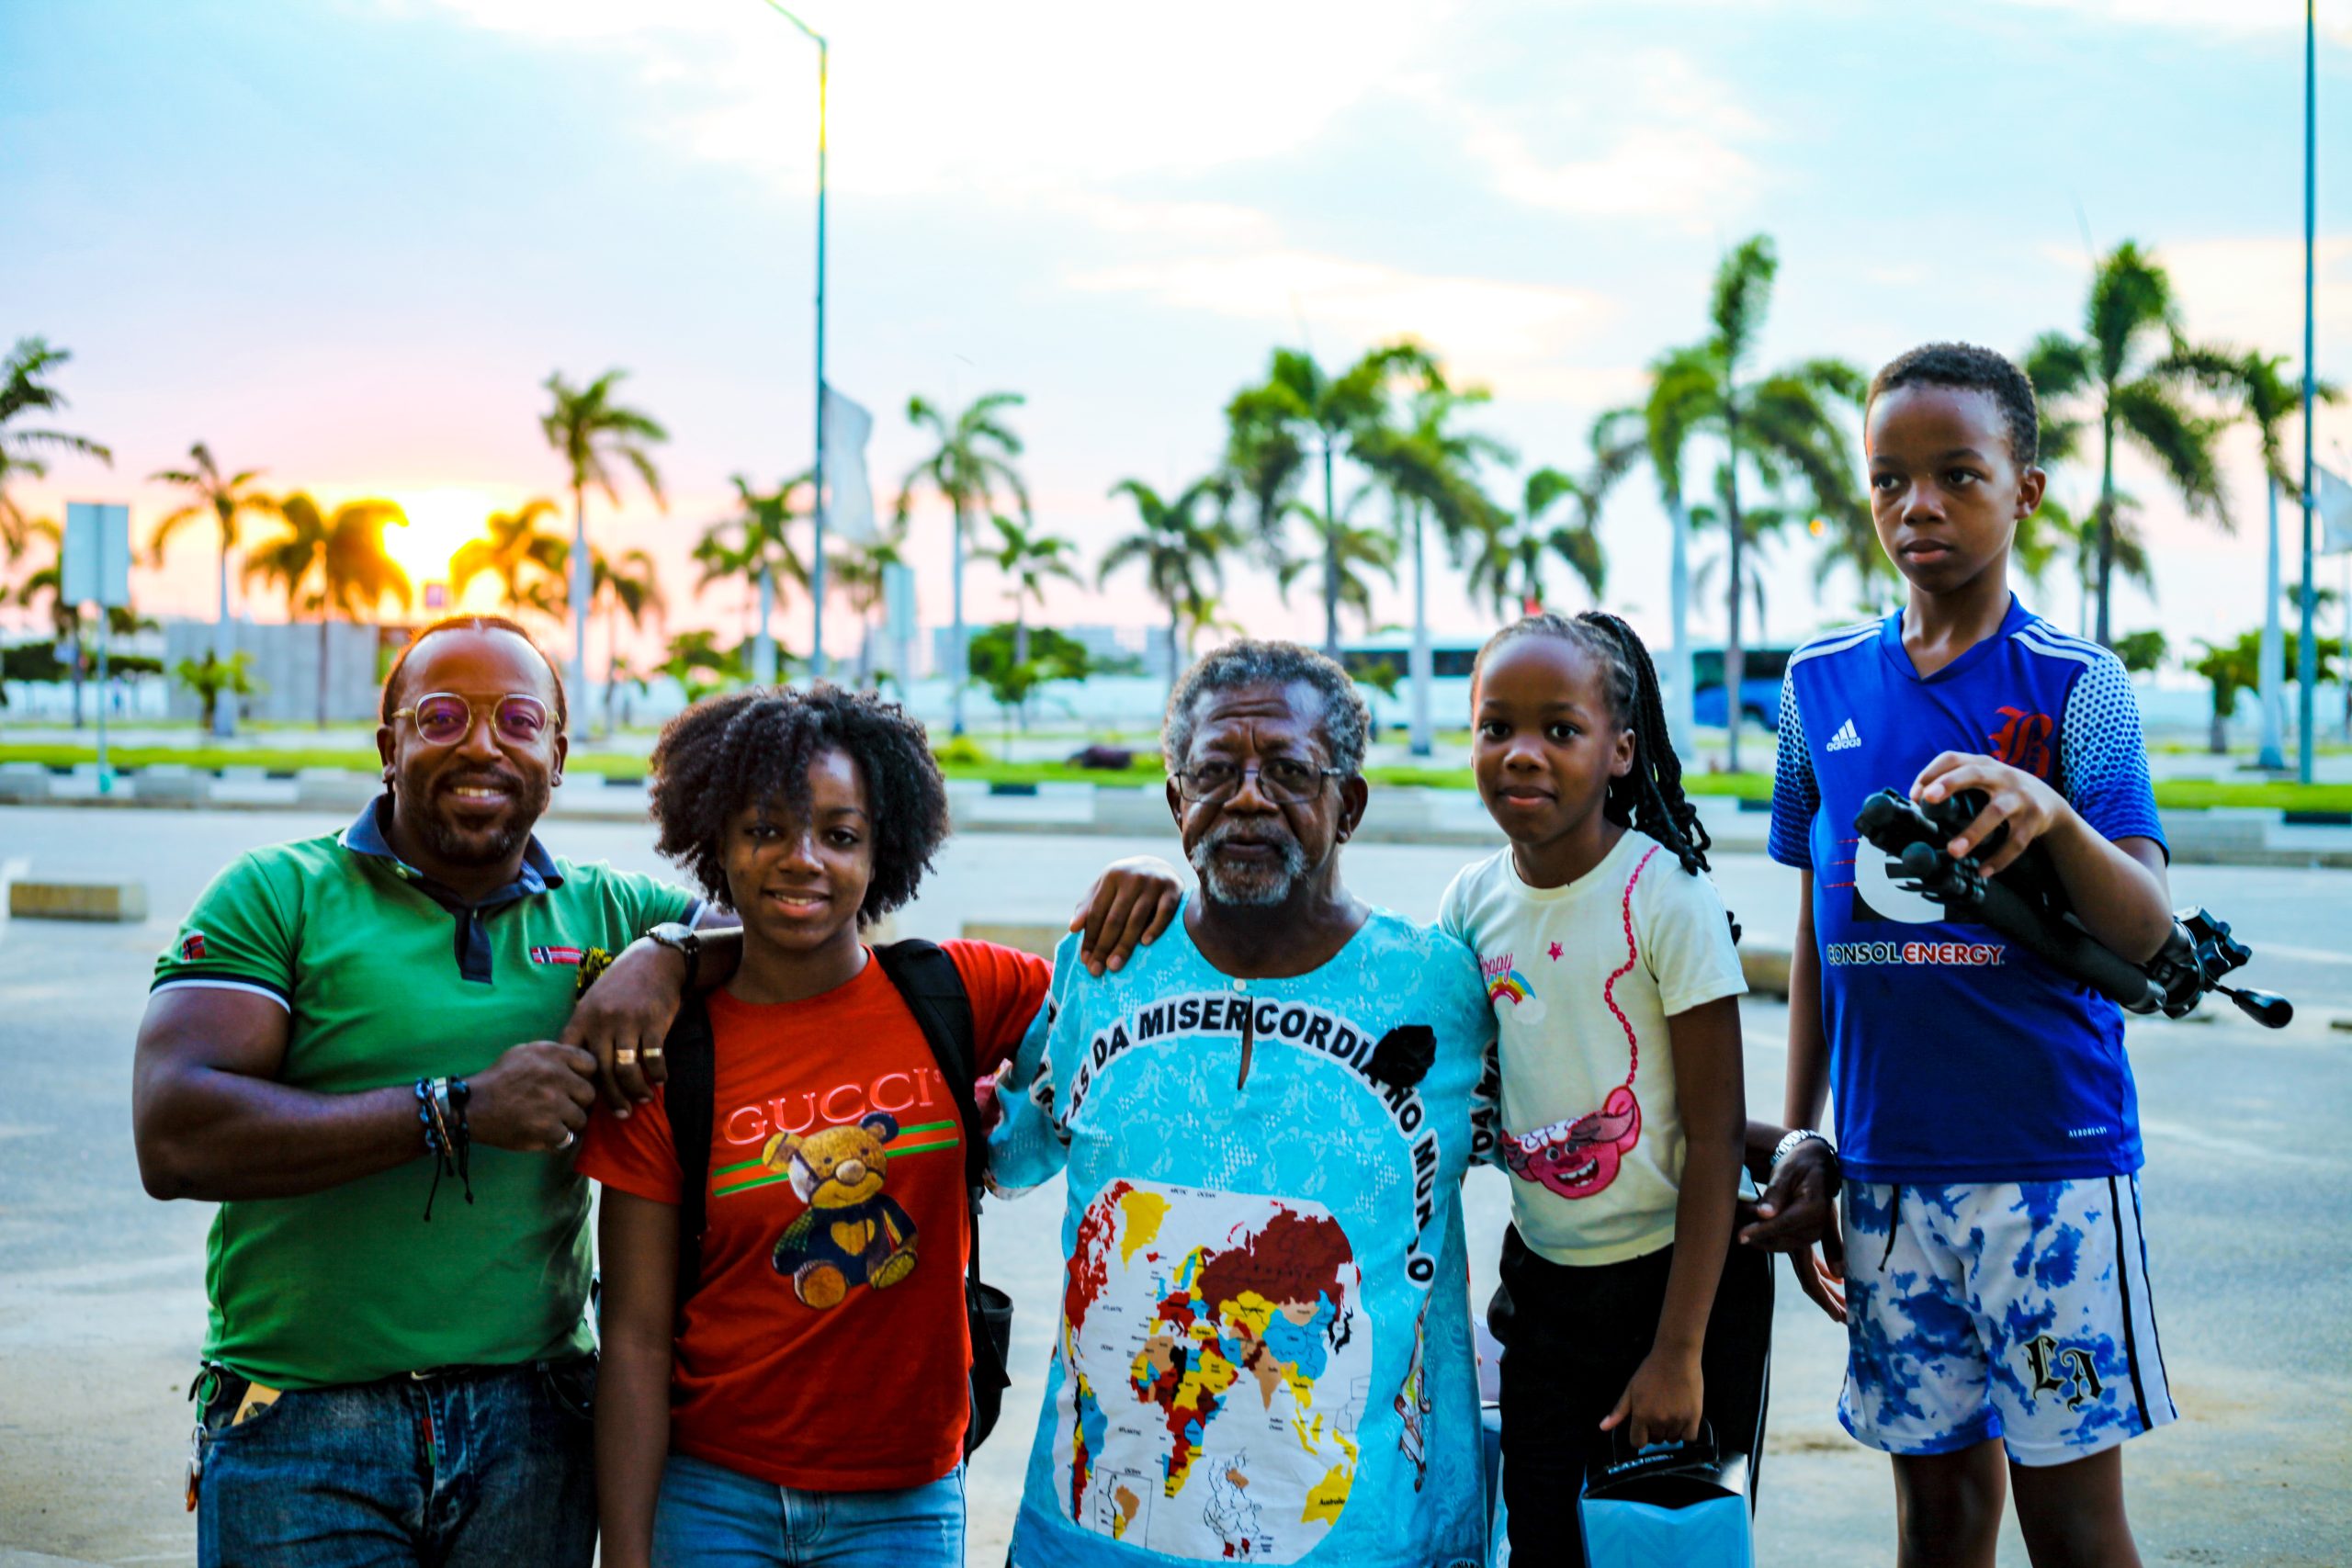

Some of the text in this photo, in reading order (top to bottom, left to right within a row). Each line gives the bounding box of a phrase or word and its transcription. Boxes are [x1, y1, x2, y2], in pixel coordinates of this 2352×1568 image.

[723, 1067, 934, 1145] GUCCI
[1093, 1021, 1130, 1071] DA
[1407, 1134, 1436, 1282] MUNO
